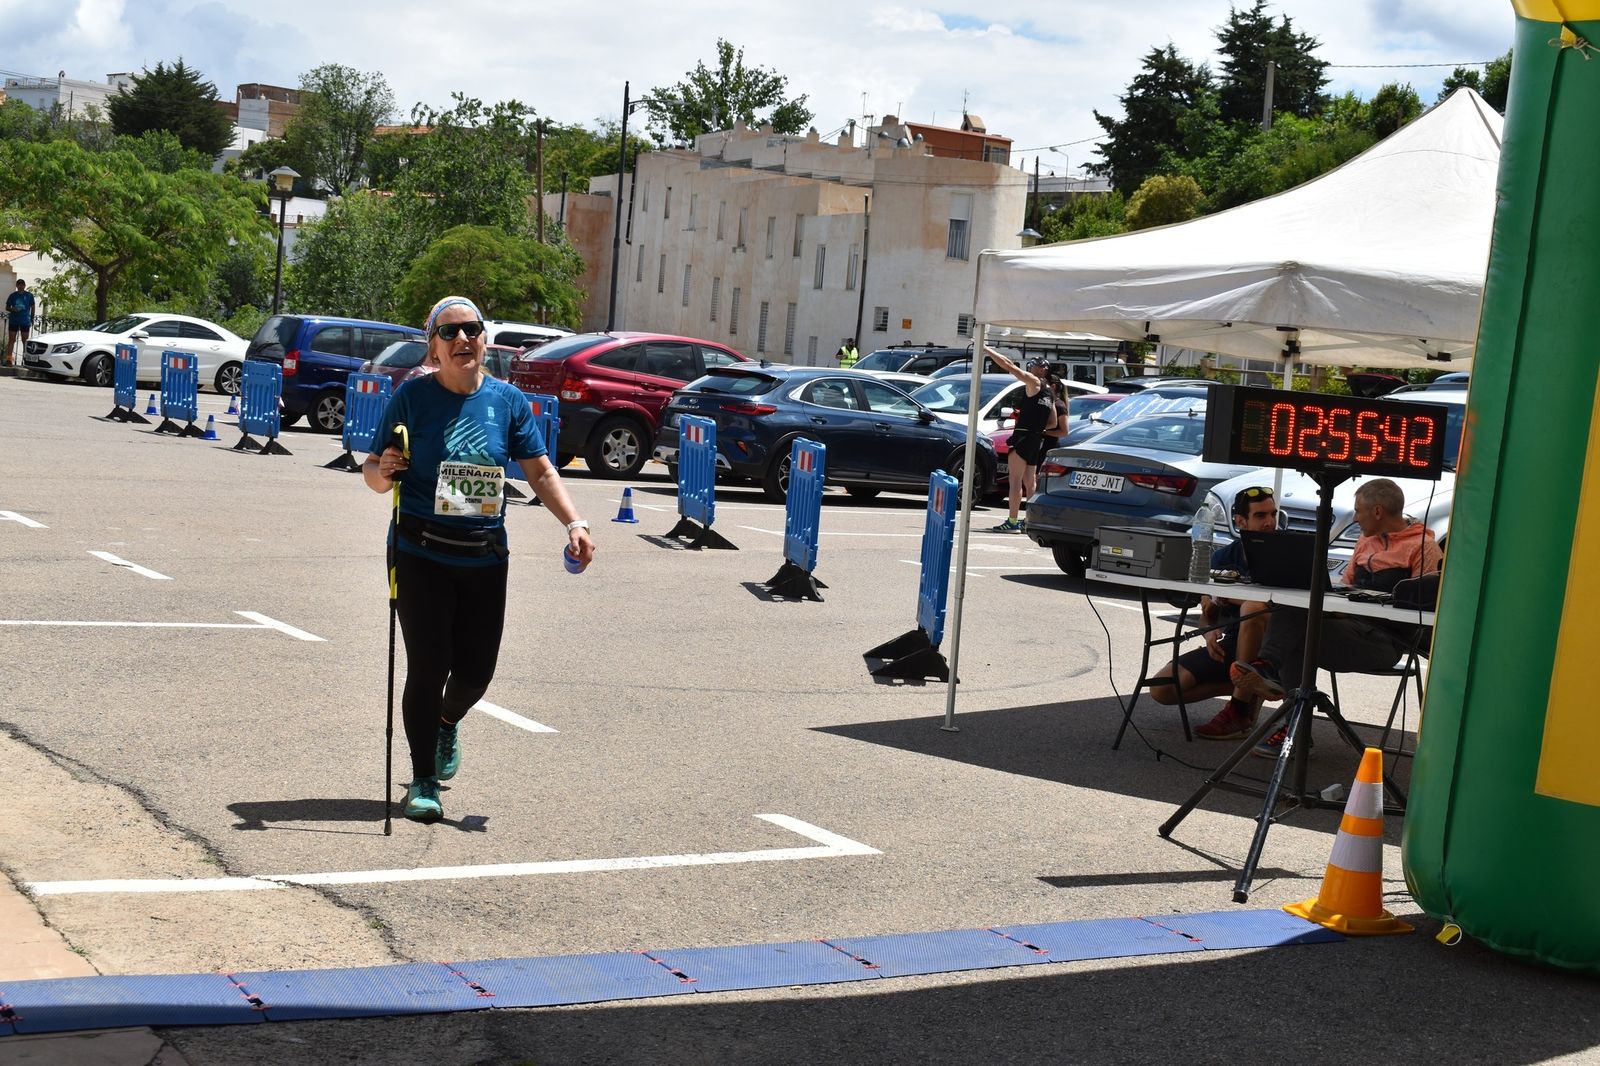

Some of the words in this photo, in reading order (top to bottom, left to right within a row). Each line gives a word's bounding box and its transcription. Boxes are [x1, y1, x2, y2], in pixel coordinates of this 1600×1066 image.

[1268, 403, 1434, 467] 02:55:42
[441, 468, 502, 479] MILENARIA
[1075, 473, 1098, 486] 9268
[1101, 477, 1121, 489] JNT
[447, 479, 498, 497] 1023
